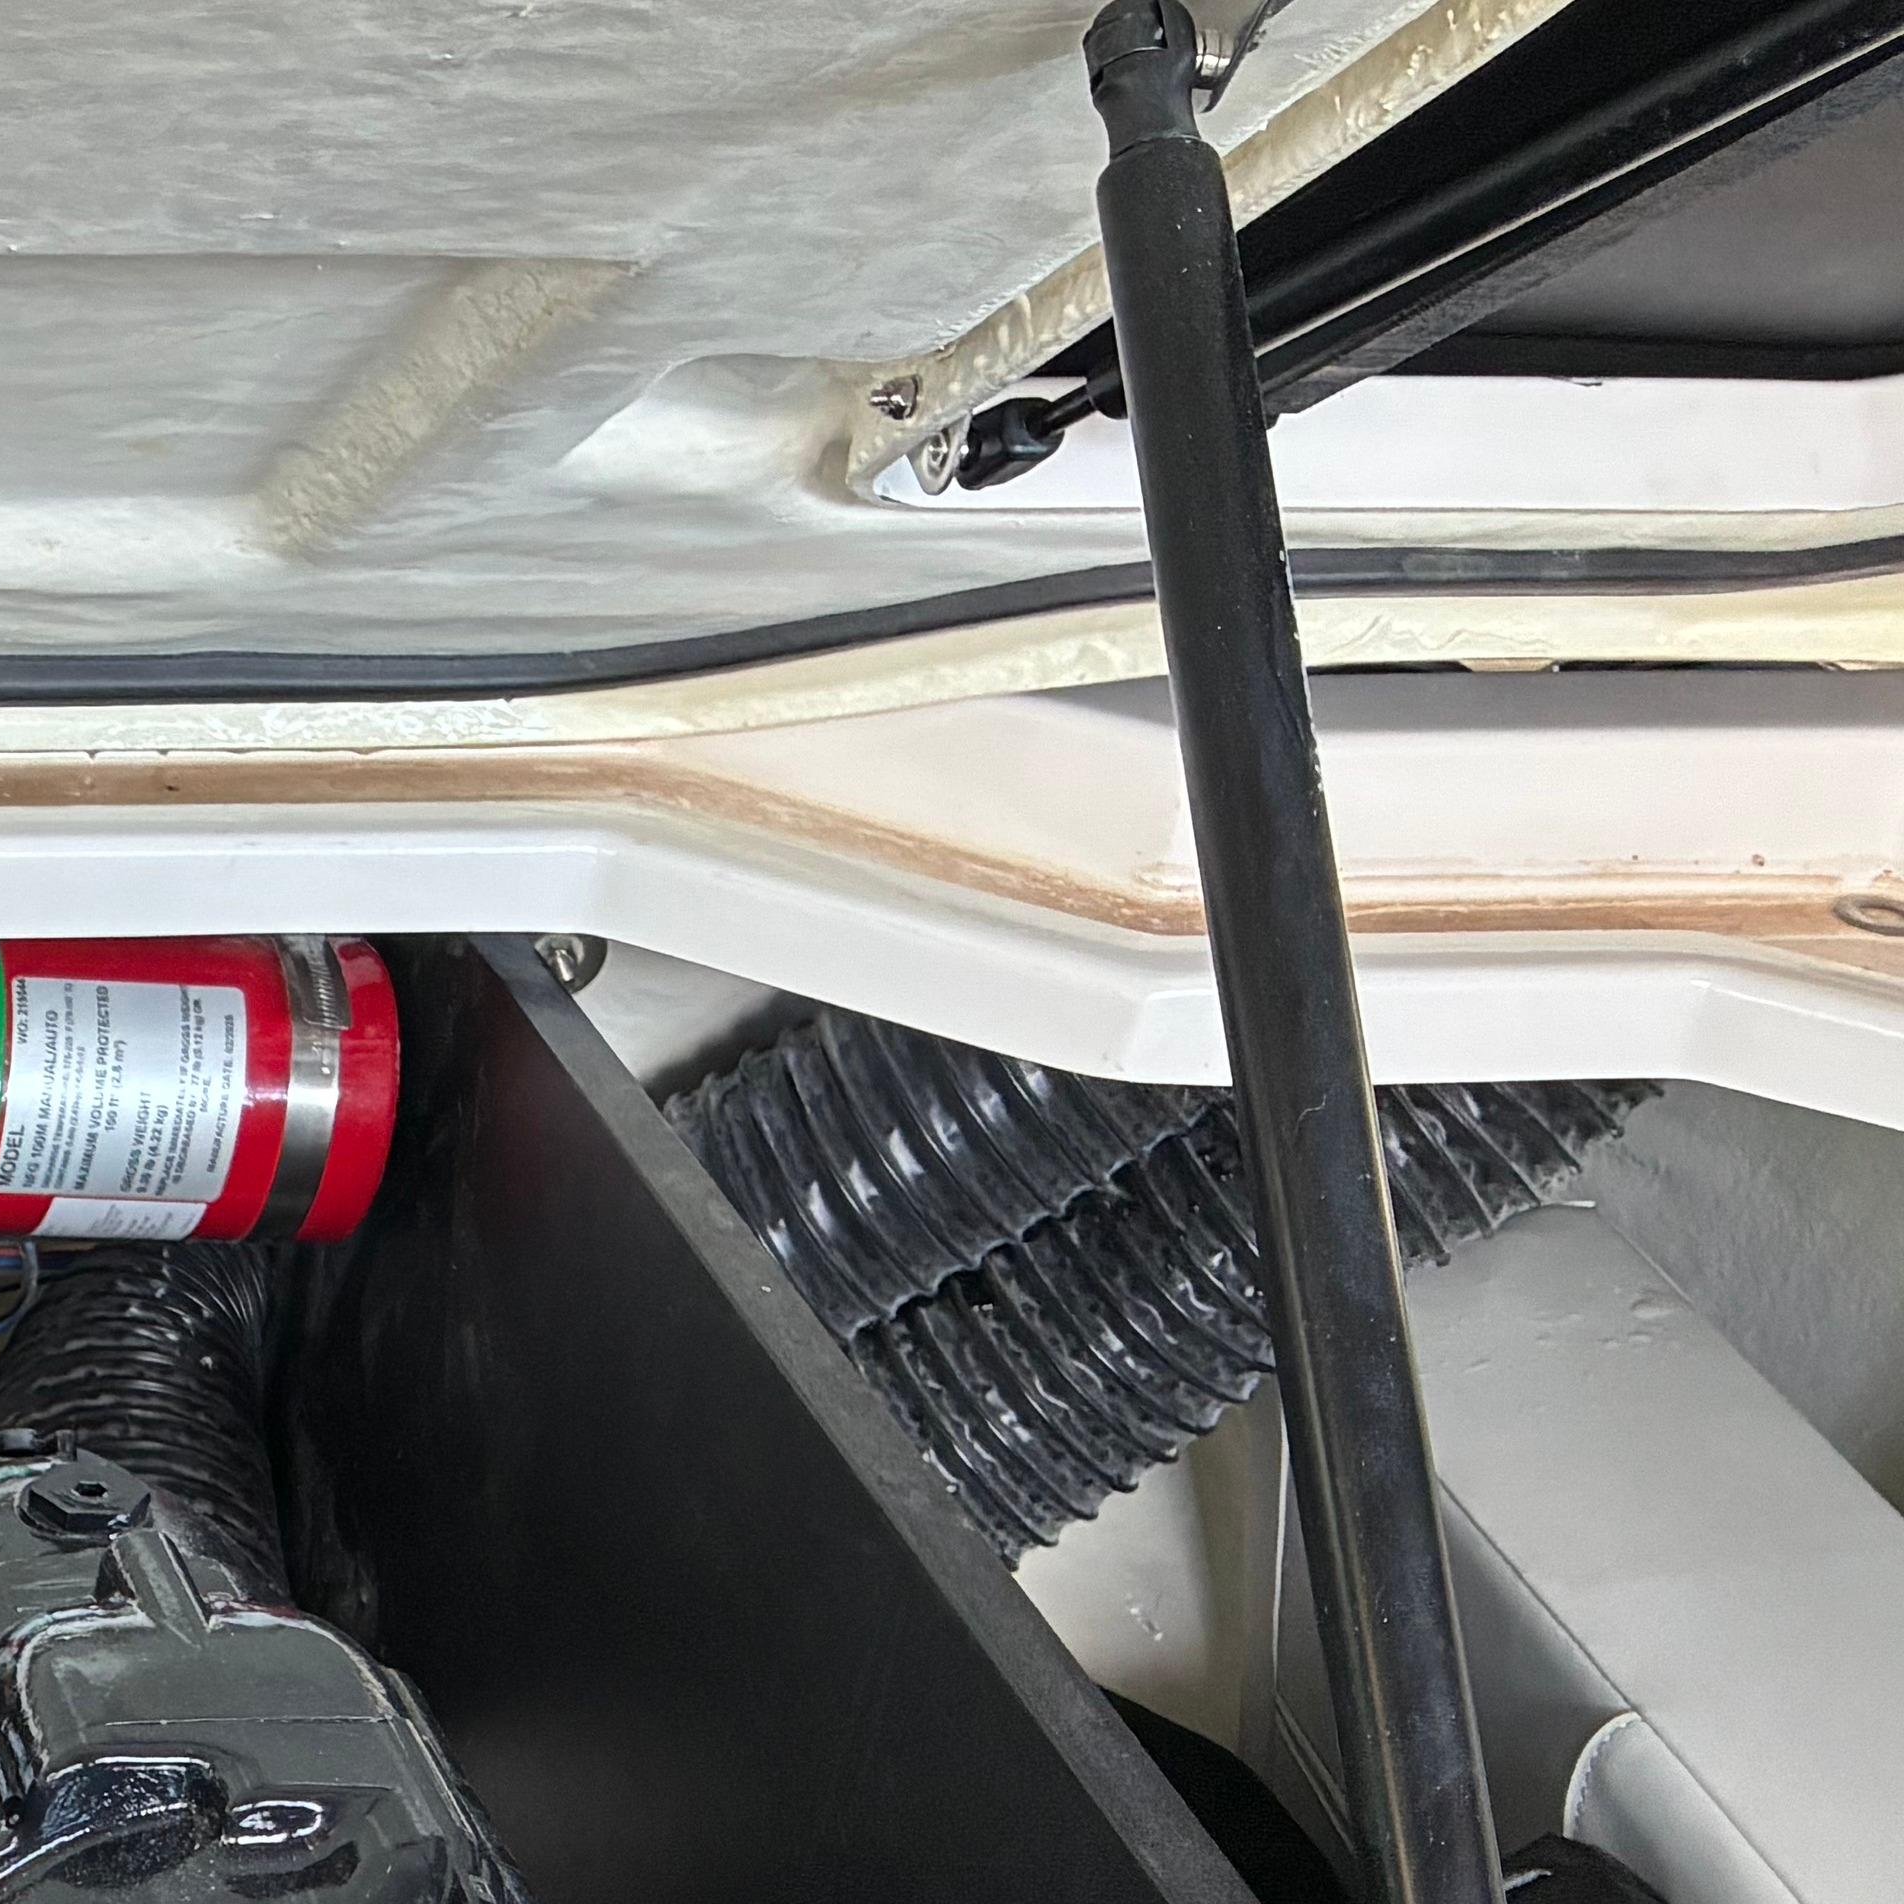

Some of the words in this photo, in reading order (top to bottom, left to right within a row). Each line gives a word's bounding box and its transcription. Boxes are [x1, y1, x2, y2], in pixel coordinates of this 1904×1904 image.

[74, 1132, 99, 1190] MAXIMUM
[96, 986, 109, 1064] PROTECTED
[132, 1092, 151, 1146] WEIGHT
